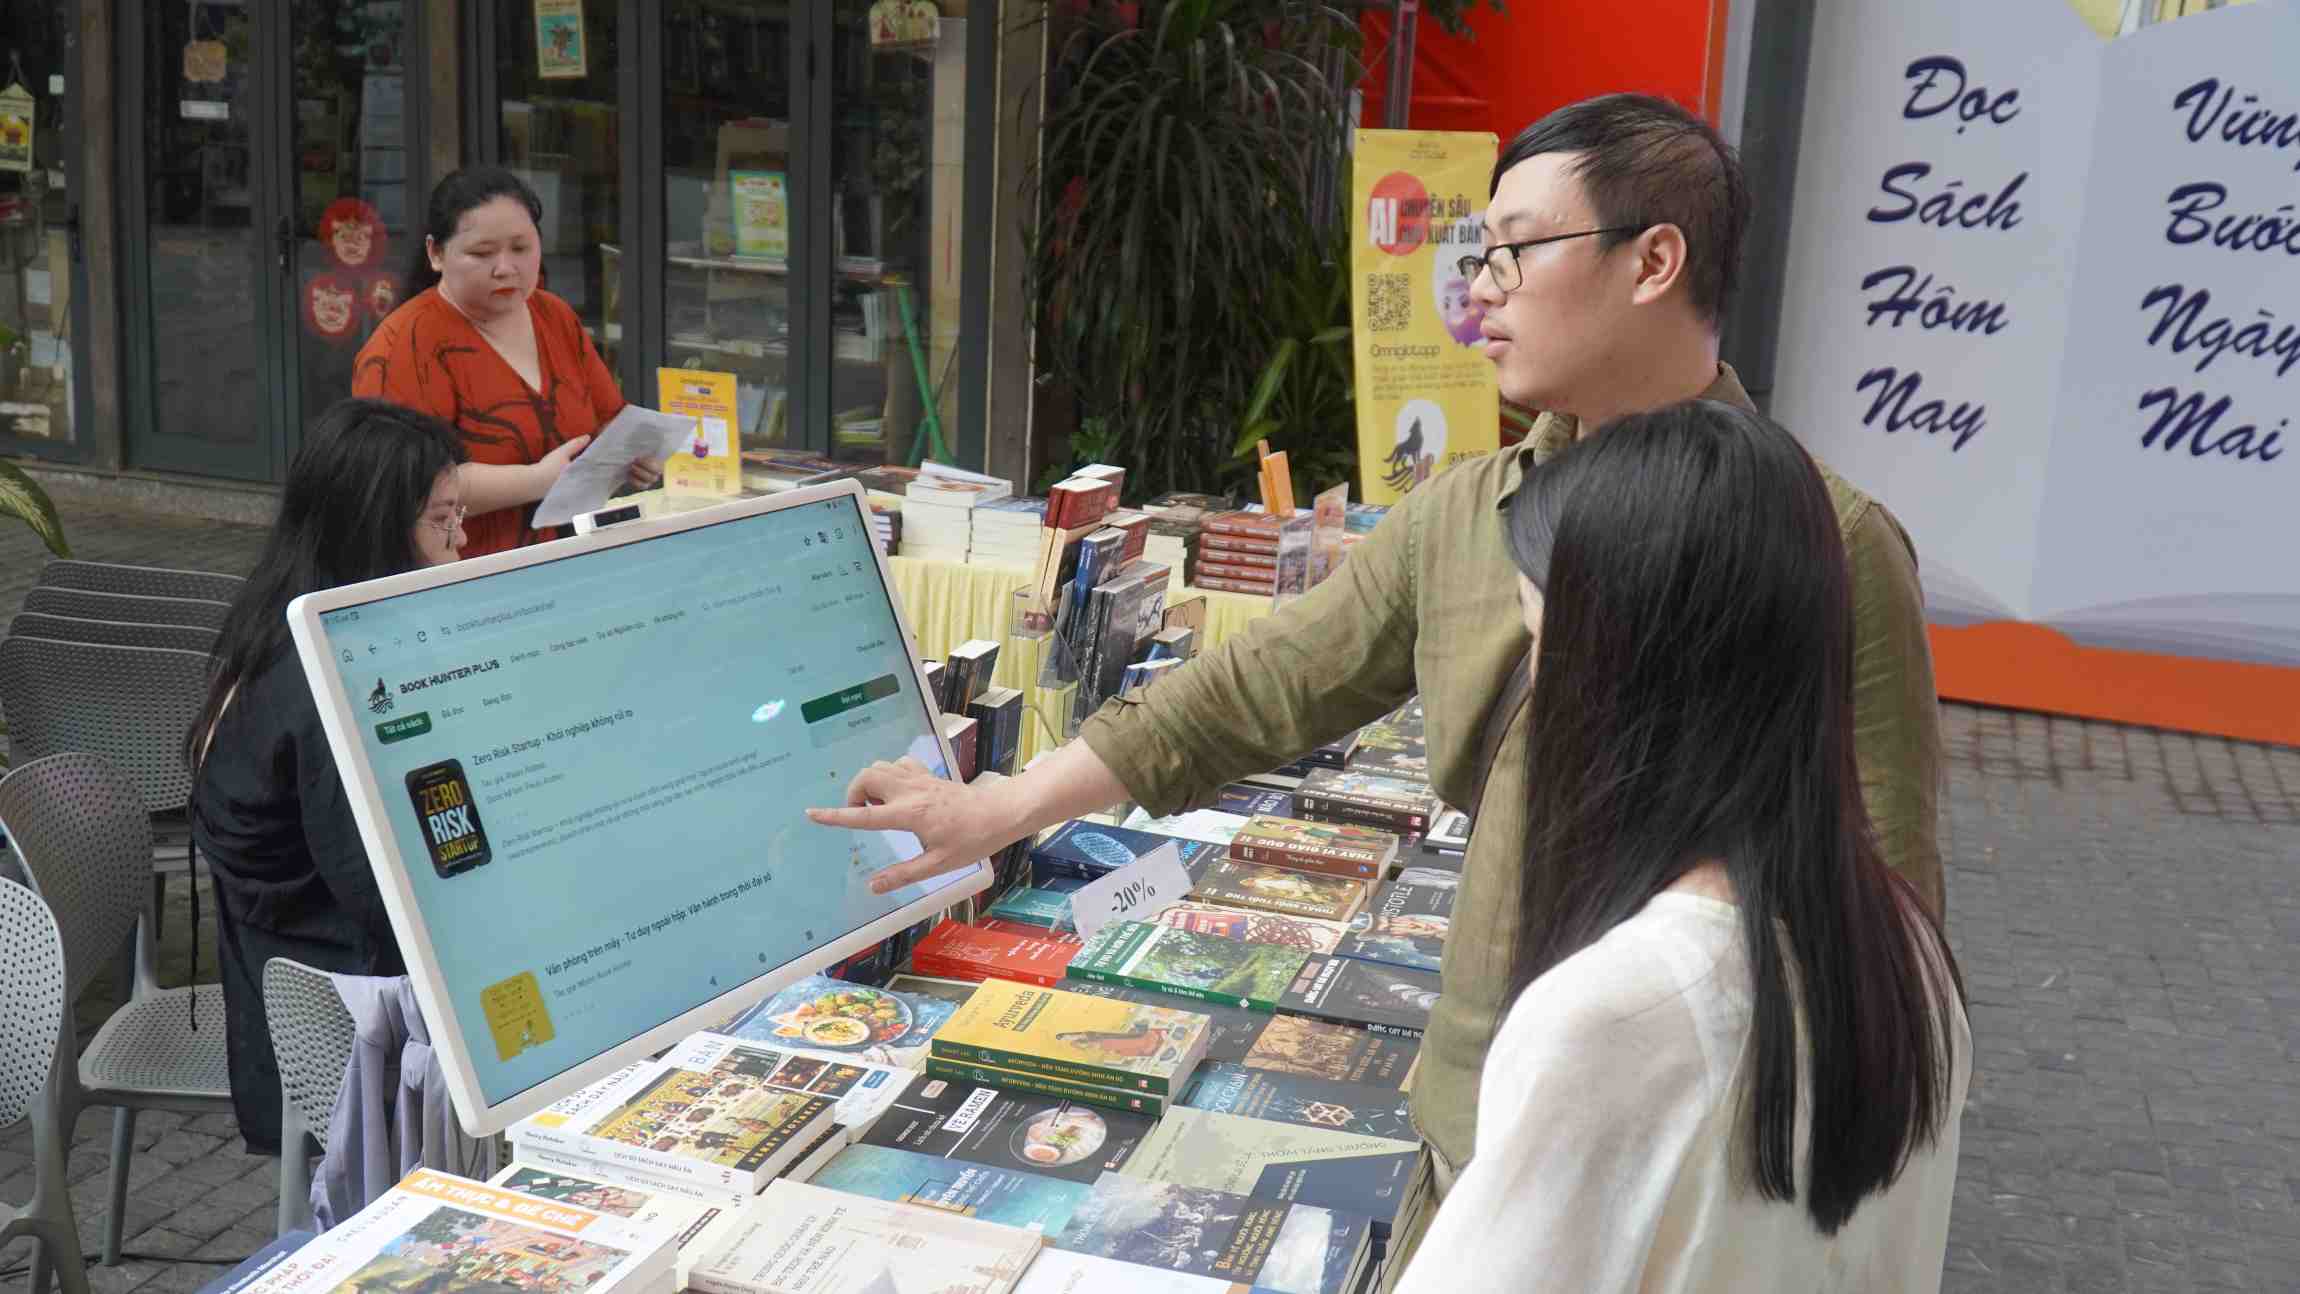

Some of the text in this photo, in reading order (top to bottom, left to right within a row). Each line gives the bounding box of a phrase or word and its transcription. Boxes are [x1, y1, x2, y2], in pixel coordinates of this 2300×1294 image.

[1903, 55, 2022, 134] Đọc
[2173, 77, 2300, 172] Vữn
[1867, 161, 2028, 231] Sách
[1369, 198, 1397, 245] AI
[1860, 265, 2009, 335] Hôm
[2141, 285, 2300, 376] Ngày
[1856, 367, 1986, 452] Nay
[2139, 387, 2289, 461] Mai
[400, 659, 499, 694] BOOK HUNTER PLUS
[472, 753, 494, 767] Zero
[493, 747, 511, 762] Risk
[511, 738, 541, 757] Startup
[419, 779, 465, 815] ZERO
[428, 806, 475, 845] RISK
[1340, 850, 1376, 861] THAY
[1111, 877, 1156, 913] -20%
[993, 990, 1034, 1029] Ayurveda
